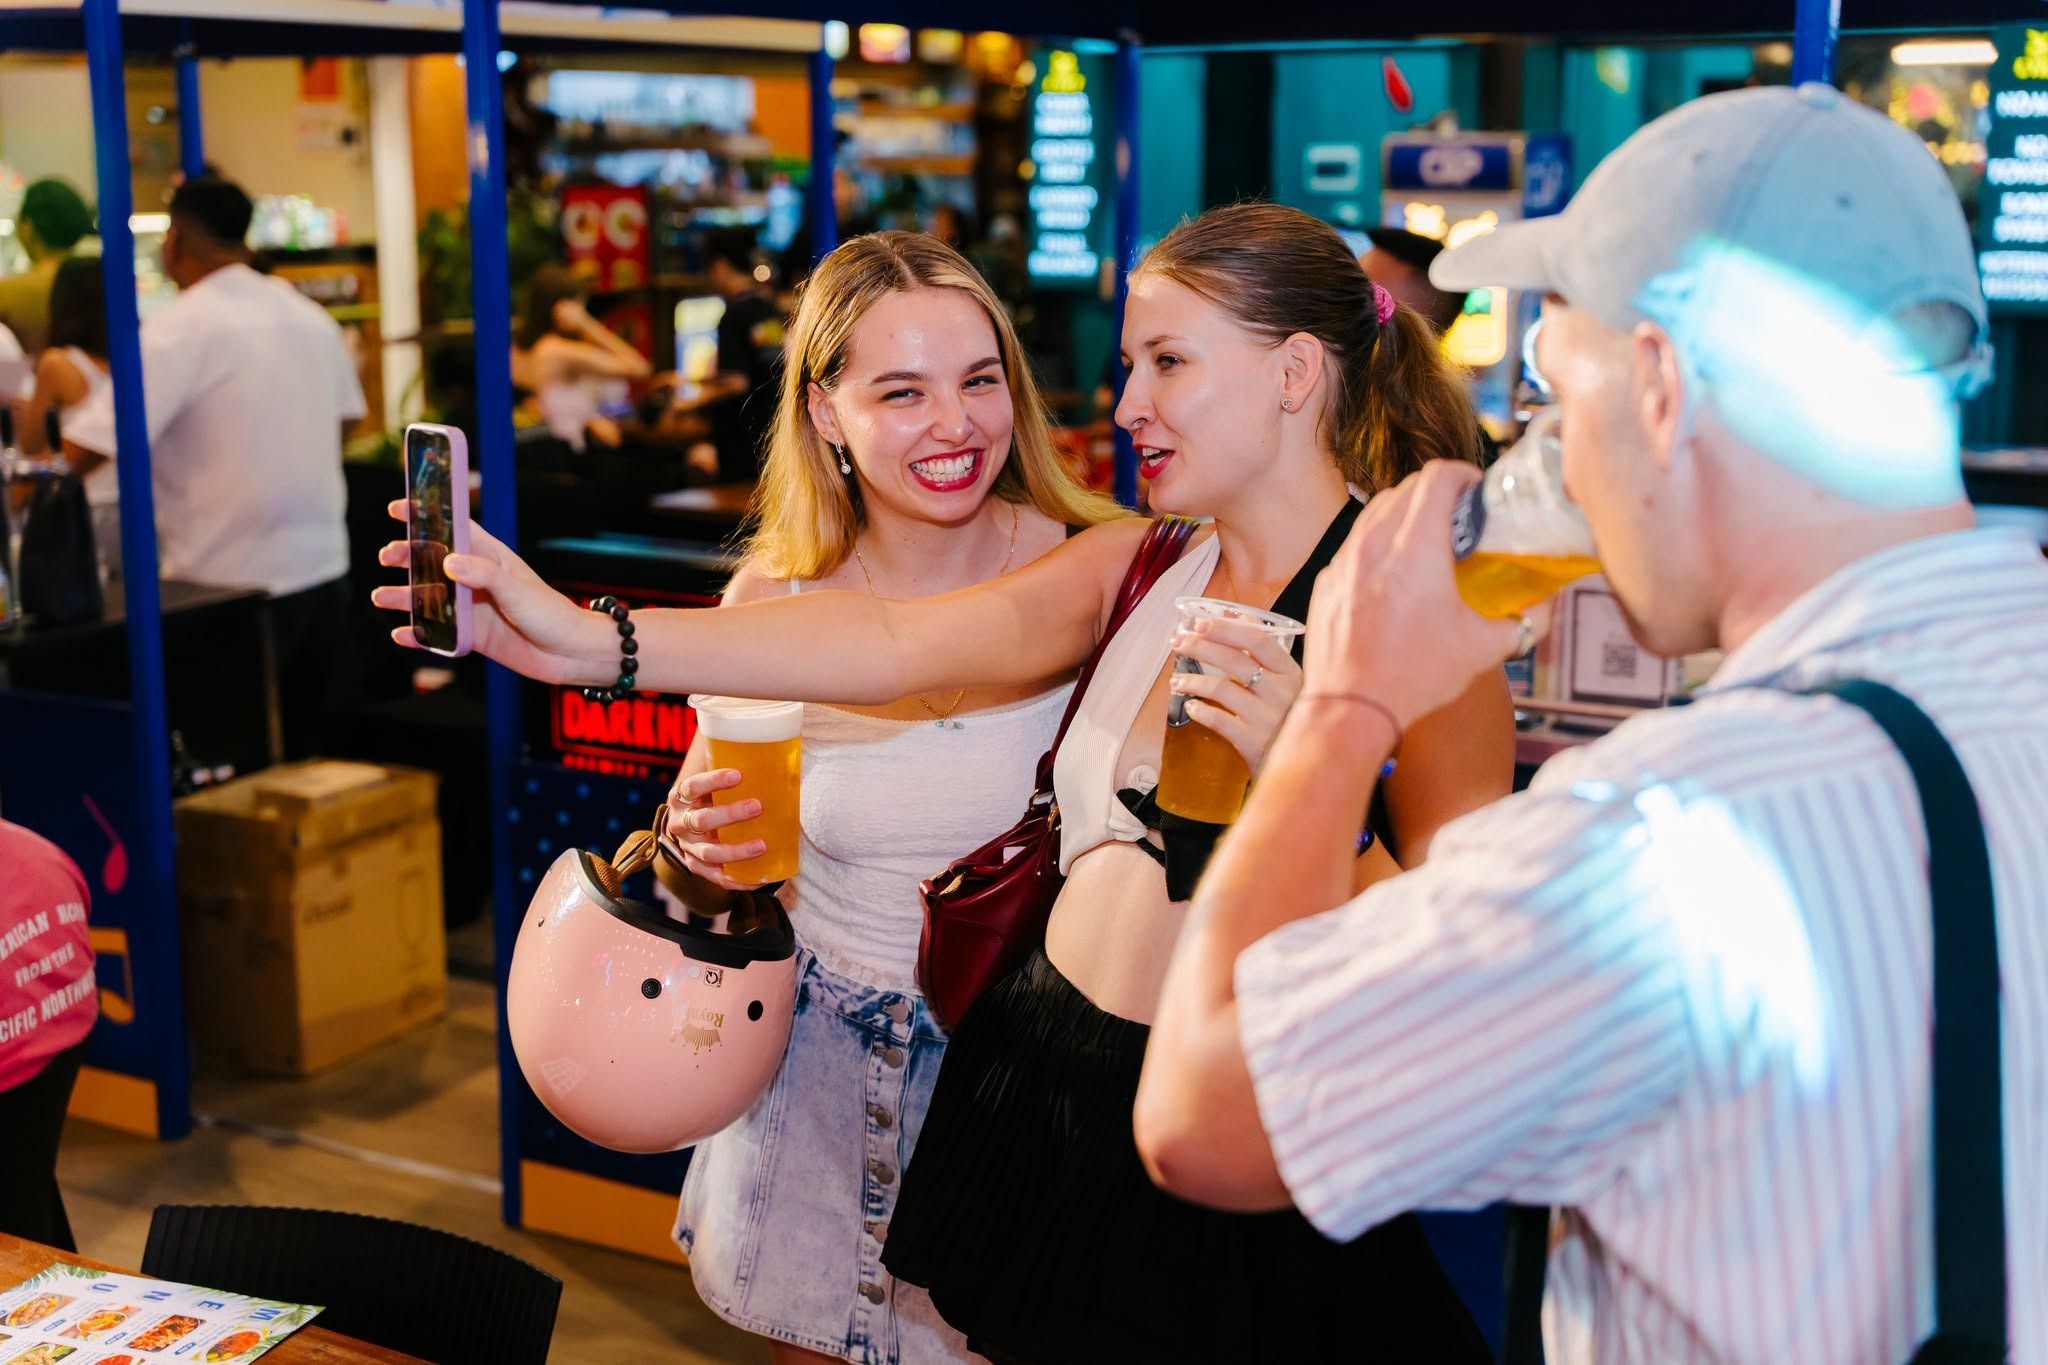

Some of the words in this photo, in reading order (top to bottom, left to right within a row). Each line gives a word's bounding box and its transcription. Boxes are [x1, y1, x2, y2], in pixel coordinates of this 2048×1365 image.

[15, 957, 53, 987] FROM
[51, 942, 75, 968] THE
[0, 1004, 37, 1043] CIFIC
[685, 1007, 725, 1029] Royl
